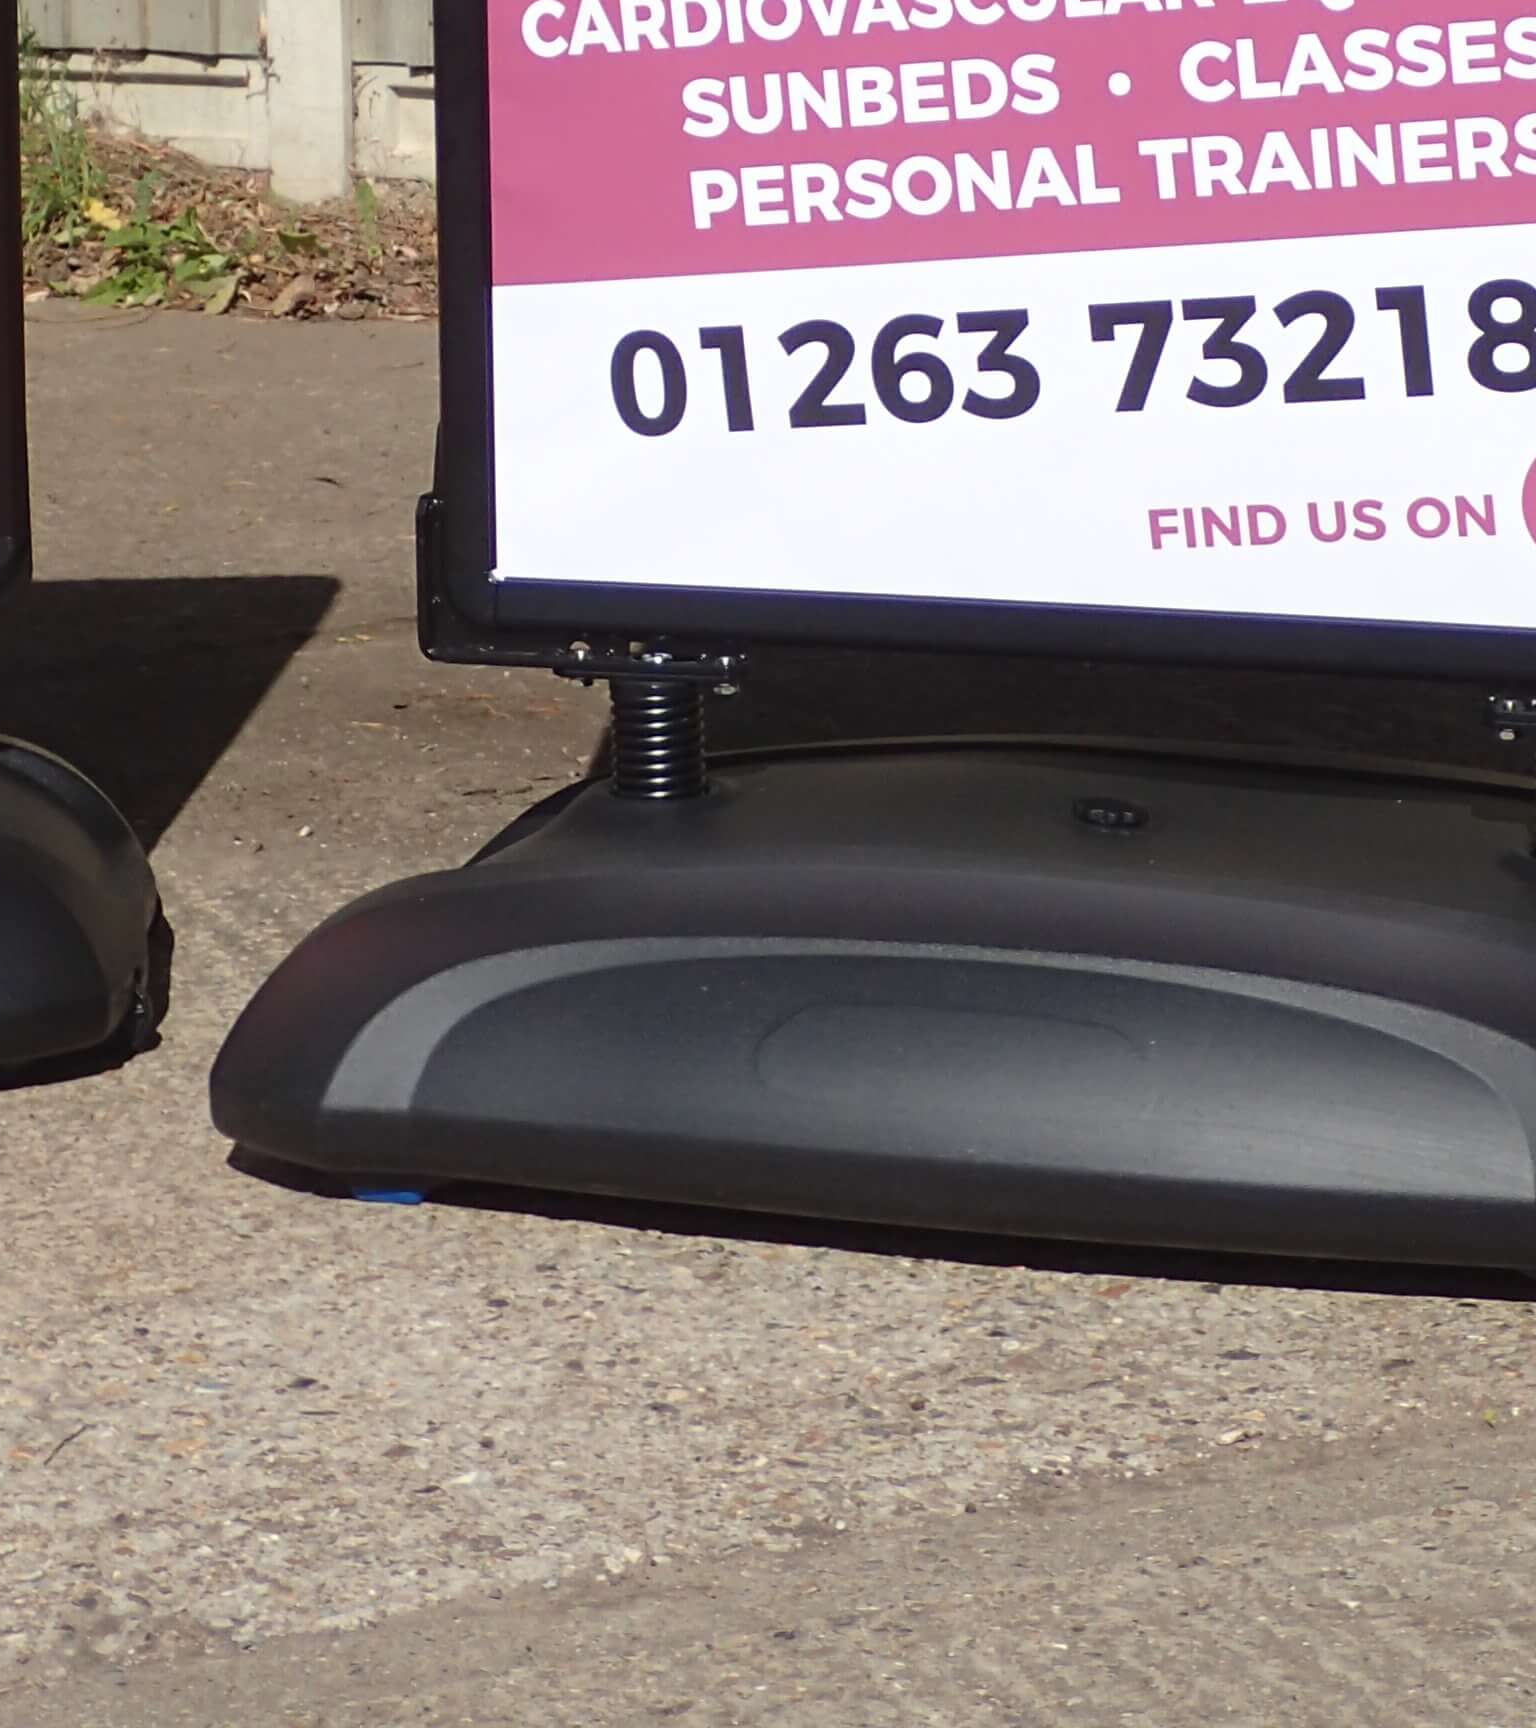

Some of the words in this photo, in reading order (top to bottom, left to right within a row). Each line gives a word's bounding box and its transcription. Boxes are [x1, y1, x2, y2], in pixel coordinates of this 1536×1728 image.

[682, 53, 1060, 138] SUNBEDS
[690, 143, 1121, 230] PERSONAL
[610, 308, 1041, 437] 01263
[1148, 504, 1287, 550] FIND
[1307, 499, 1387, 543] US
[1406, 494, 1497, 539] ON
